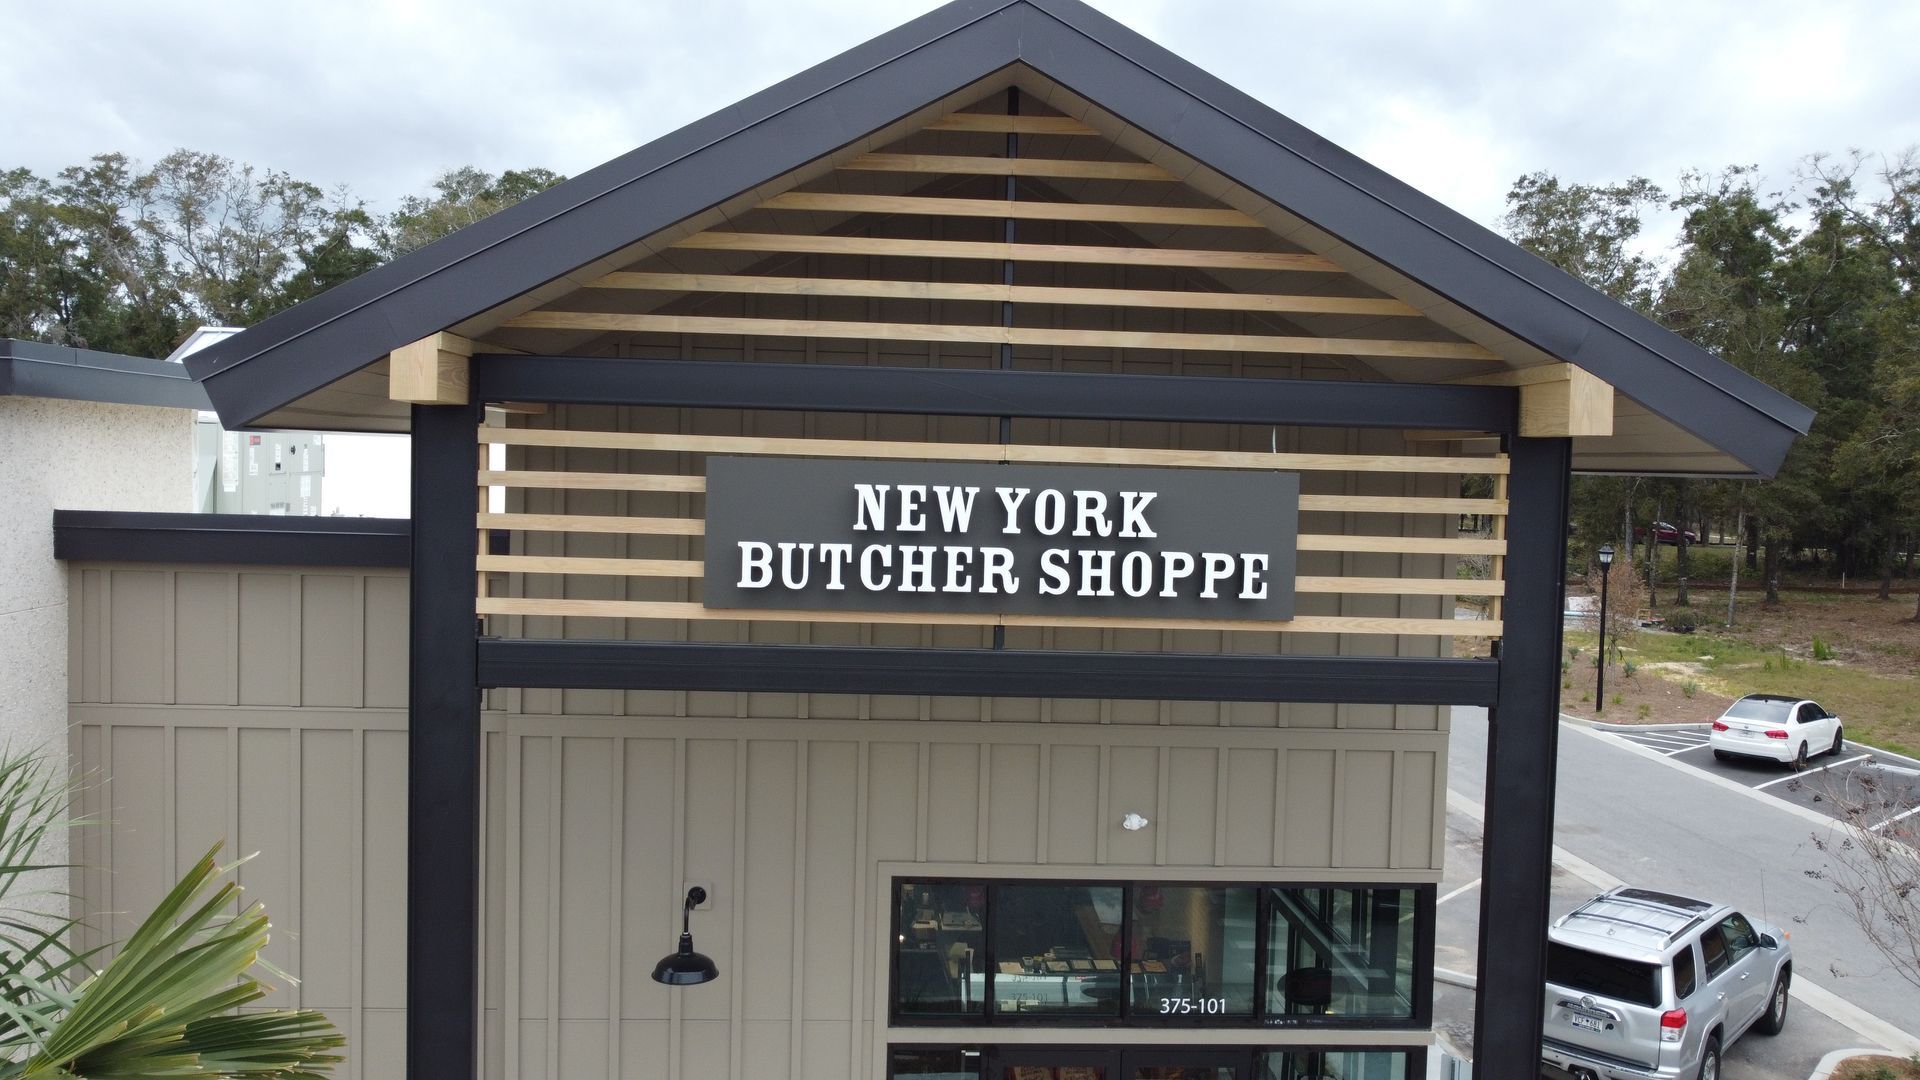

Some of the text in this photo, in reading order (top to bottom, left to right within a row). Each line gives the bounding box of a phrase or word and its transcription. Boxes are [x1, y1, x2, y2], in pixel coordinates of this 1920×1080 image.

[853, 484, 1157, 539] NEW YORK
[737, 541, 1269, 601] BUTCHER SHOPPE
[1160, 998, 1225, 1014] 375-101
